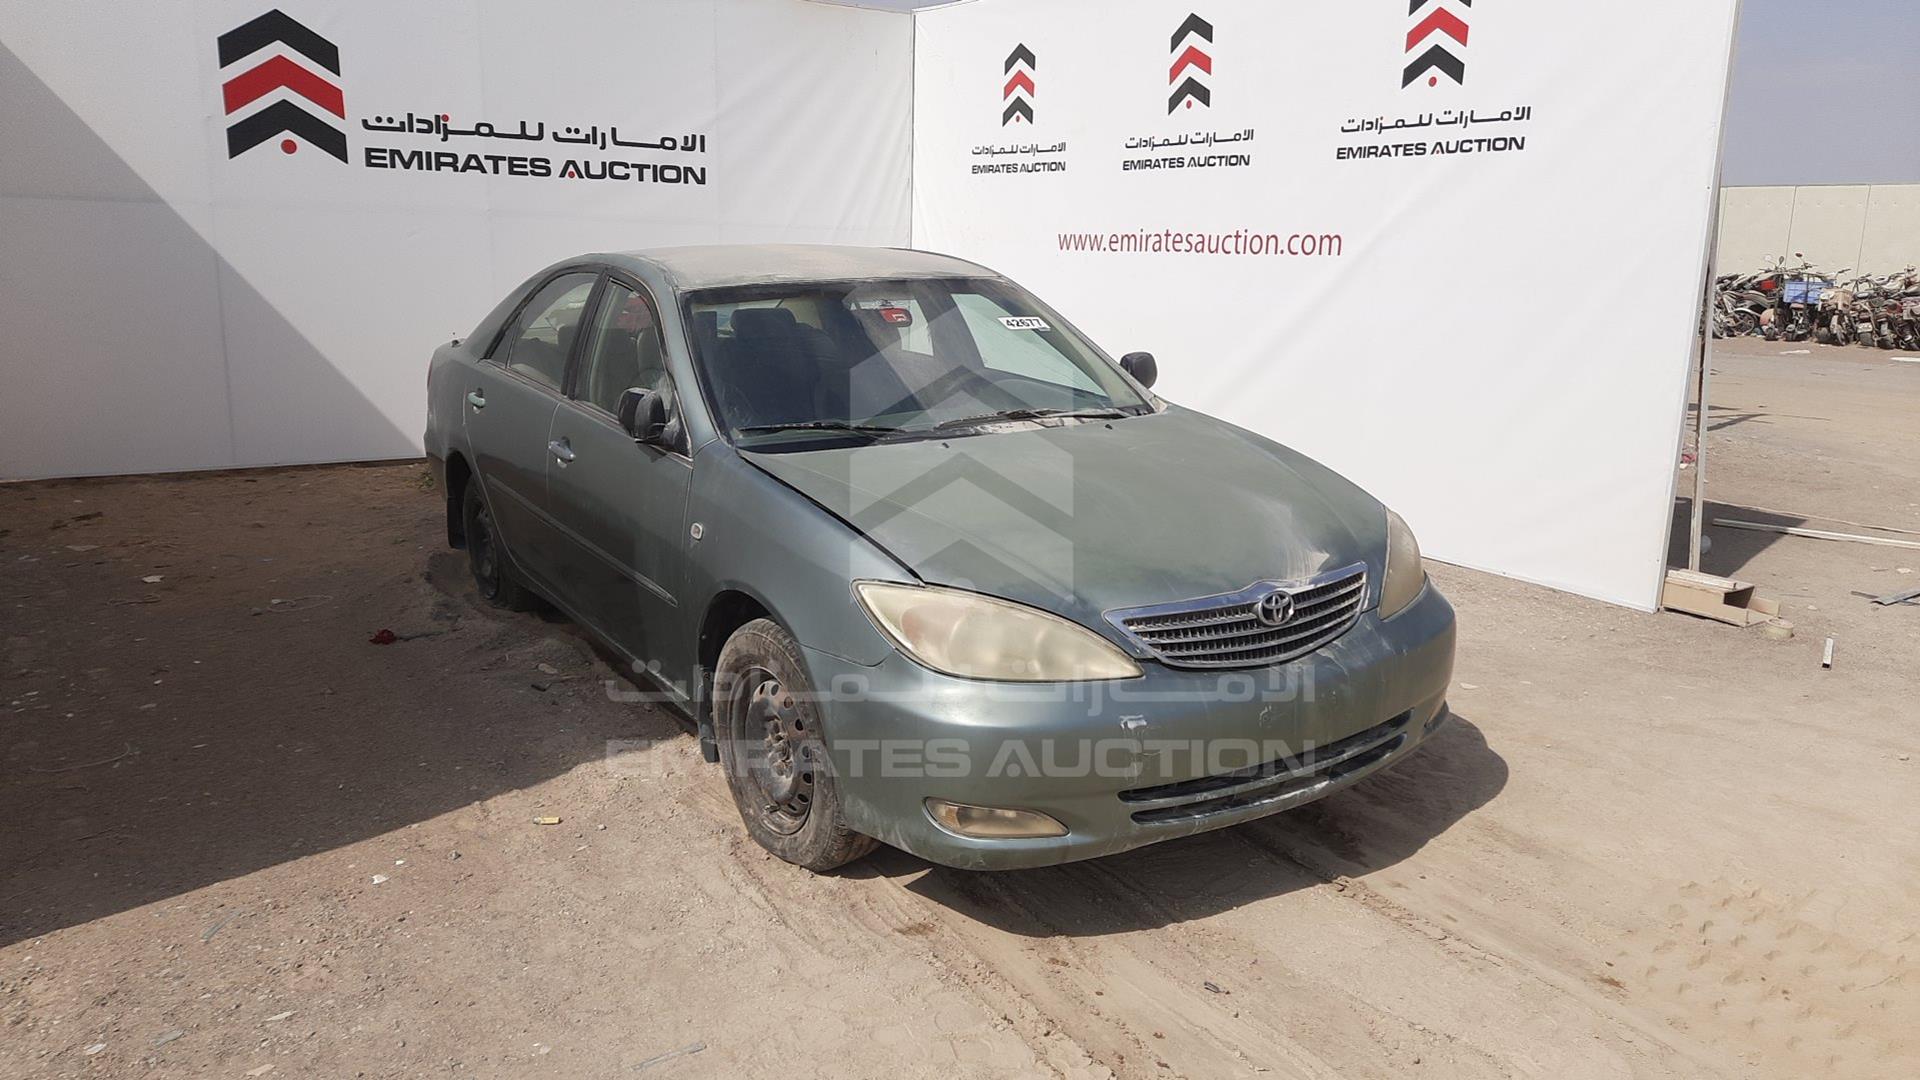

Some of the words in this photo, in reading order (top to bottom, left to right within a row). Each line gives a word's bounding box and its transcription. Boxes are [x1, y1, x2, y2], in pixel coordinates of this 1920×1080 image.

[361, 112, 544, 142] للمزادات
[1341, 113, 1433, 135] للمزادات
[1435, 106, 1531, 129] الامارات
[552, 126, 706, 153] الامارات
[1125, 134, 1188, 151] للمزادات
[1190, 129, 1254, 147] الامارات
[1336, 142, 1427, 160] EMIRATES
[1430, 136, 1526, 155] AUCTION
[364, 147, 551, 177] EMIRATES
[558, 159, 706, 185] AUCTION
[971, 163, 1019, 174] EMIRATES
[1019, 161, 1066, 173] AUCTION
[1122, 156, 1185, 171] EMIRATES
[1187, 154, 1250, 168] AUCTION
[1058, 229, 1342, 256] www.emiratesauction.com
